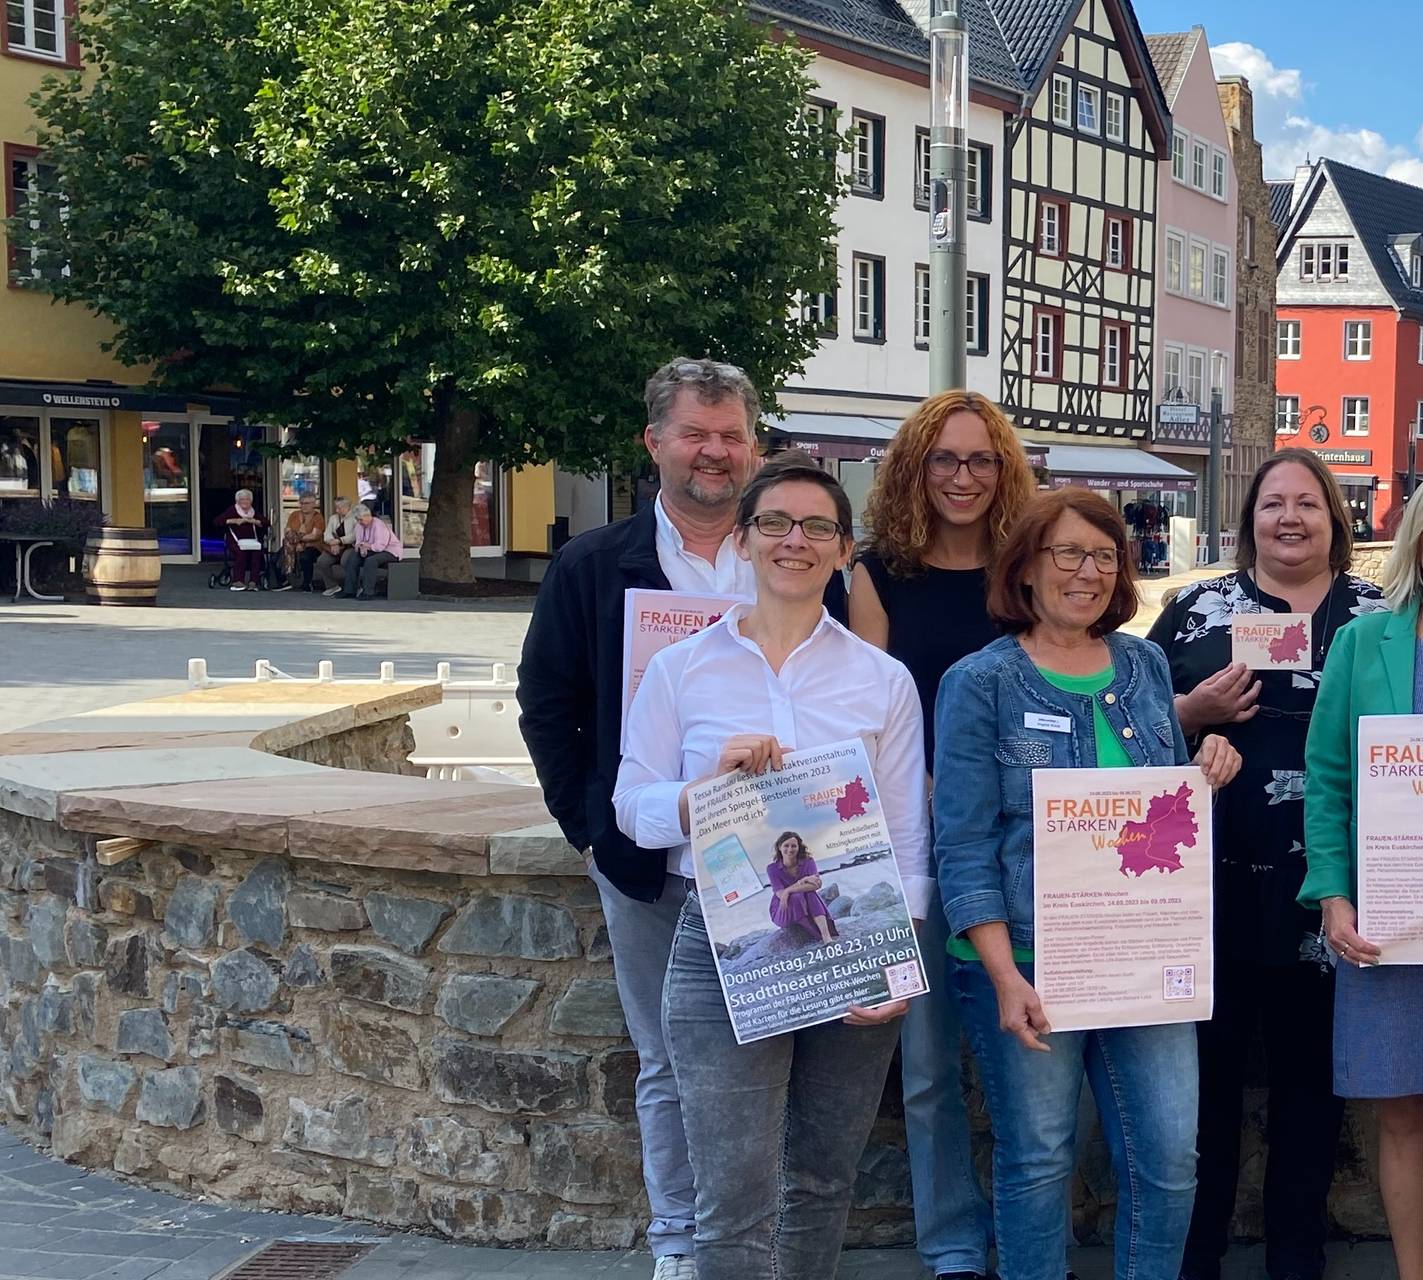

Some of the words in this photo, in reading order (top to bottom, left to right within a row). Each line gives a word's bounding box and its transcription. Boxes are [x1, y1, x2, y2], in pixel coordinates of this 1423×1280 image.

[53, 395, 110, 406] WELLENSTEYN
[640, 611, 704, 627] FRAUEN
[1235, 627, 1280, 636] FRAUEN
[694, 789, 712, 801] Tessa
[695, 804, 706, 814] der
[811, 765, 831, 778] 2023
[802, 787, 844, 804] FRAUEN
[696, 816, 707, 826] aus
[708, 807, 727, 819] ihrem
[1046, 798, 1142, 818] FRAUEN
[712, 819, 731, 831] Meer
[733, 813, 750, 824] und
[1046, 817, 1117, 833] STÄRKEN
[1092, 825, 1147, 851] Wochen
[724, 958, 806, 988] Donnerstag,
[807, 939, 868, 966] 24.08.23,
[868, 932, 884, 947] 19
[887, 926, 912, 943] Uhr
[729, 970, 829, 1008] Stadttheater
[833, 946, 916, 979] Euskirchen
[733, 1003, 771, 1020] Programm
[773, 999, 785, 1010] der
[737, 1019, 752, 1031] und
[752, 1014, 777, 1027] Karten
[777, 1010, 789, 1021] für
[789, 1005, 801, 1016] die
[801, 1000, 828, 1014] Lesung
[829, 996, 844, 1007] gibt
[845, 993, 853, 1001] es
